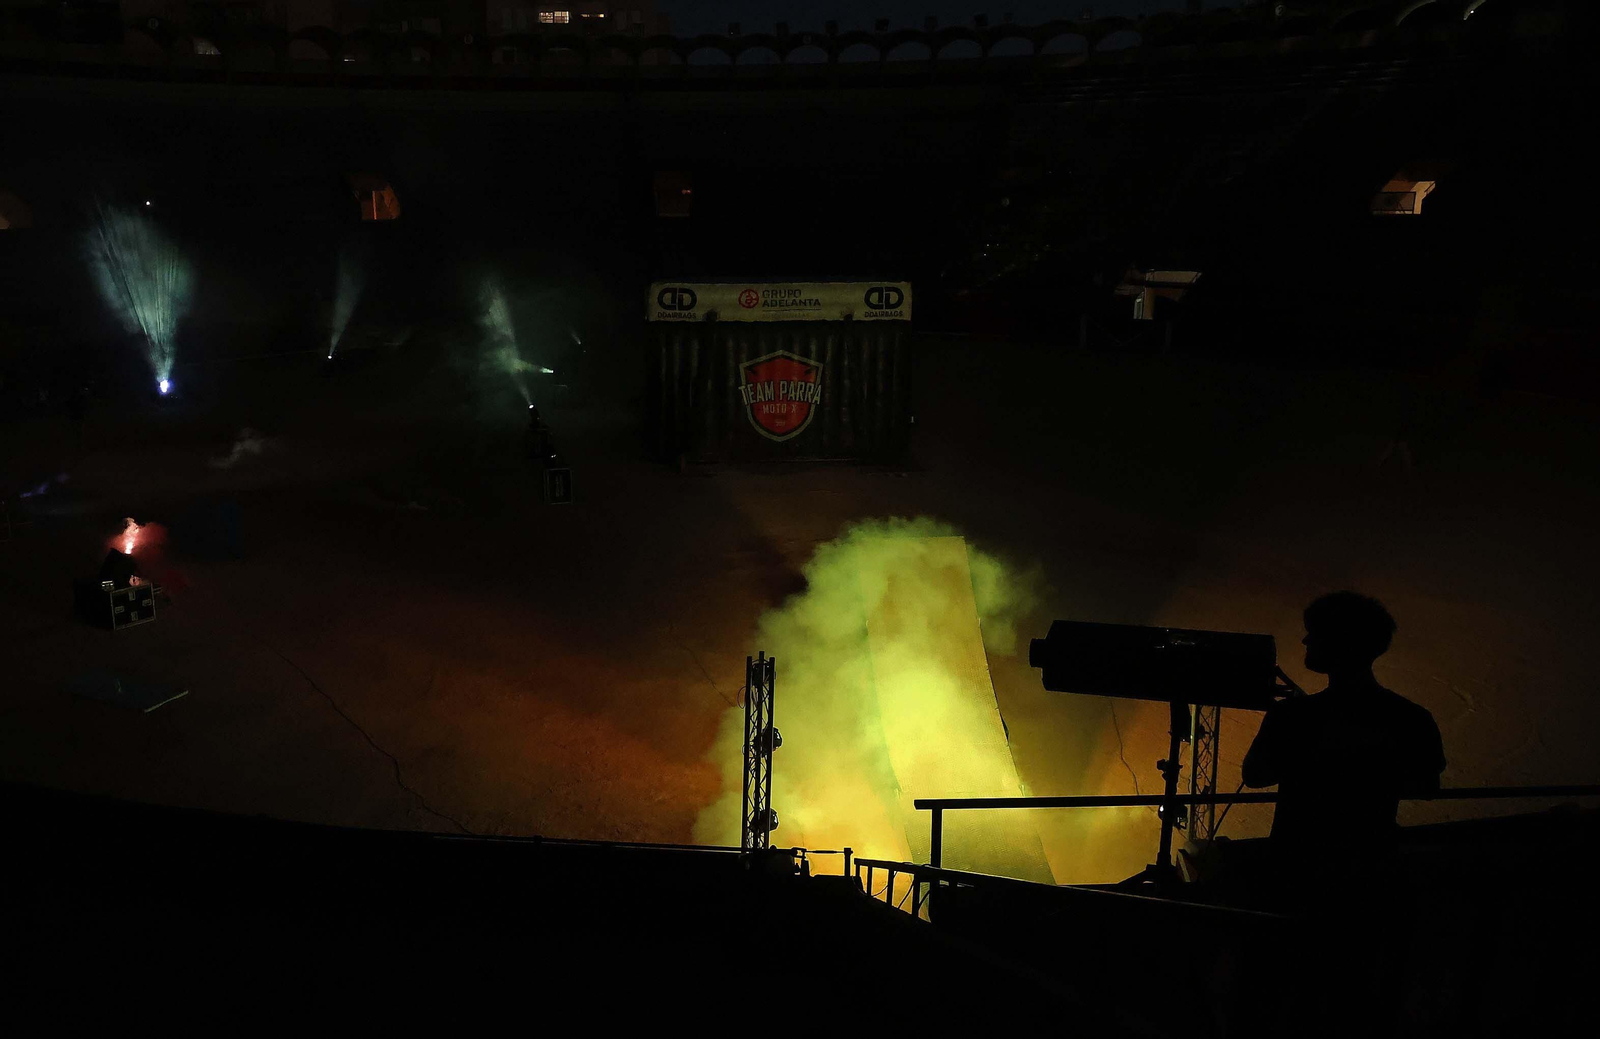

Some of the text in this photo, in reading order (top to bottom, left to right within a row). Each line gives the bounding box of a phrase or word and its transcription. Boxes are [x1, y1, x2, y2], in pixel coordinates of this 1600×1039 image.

[762, 289, 802, 298] GRUPO
[762, 298, 821, 307] ADELANTA
[864, 310, 904, 318] DDAIRBAGS
[738, 381, 822, 405] TEAM PARRA
[763, 404, 798, 414] MOTO X
